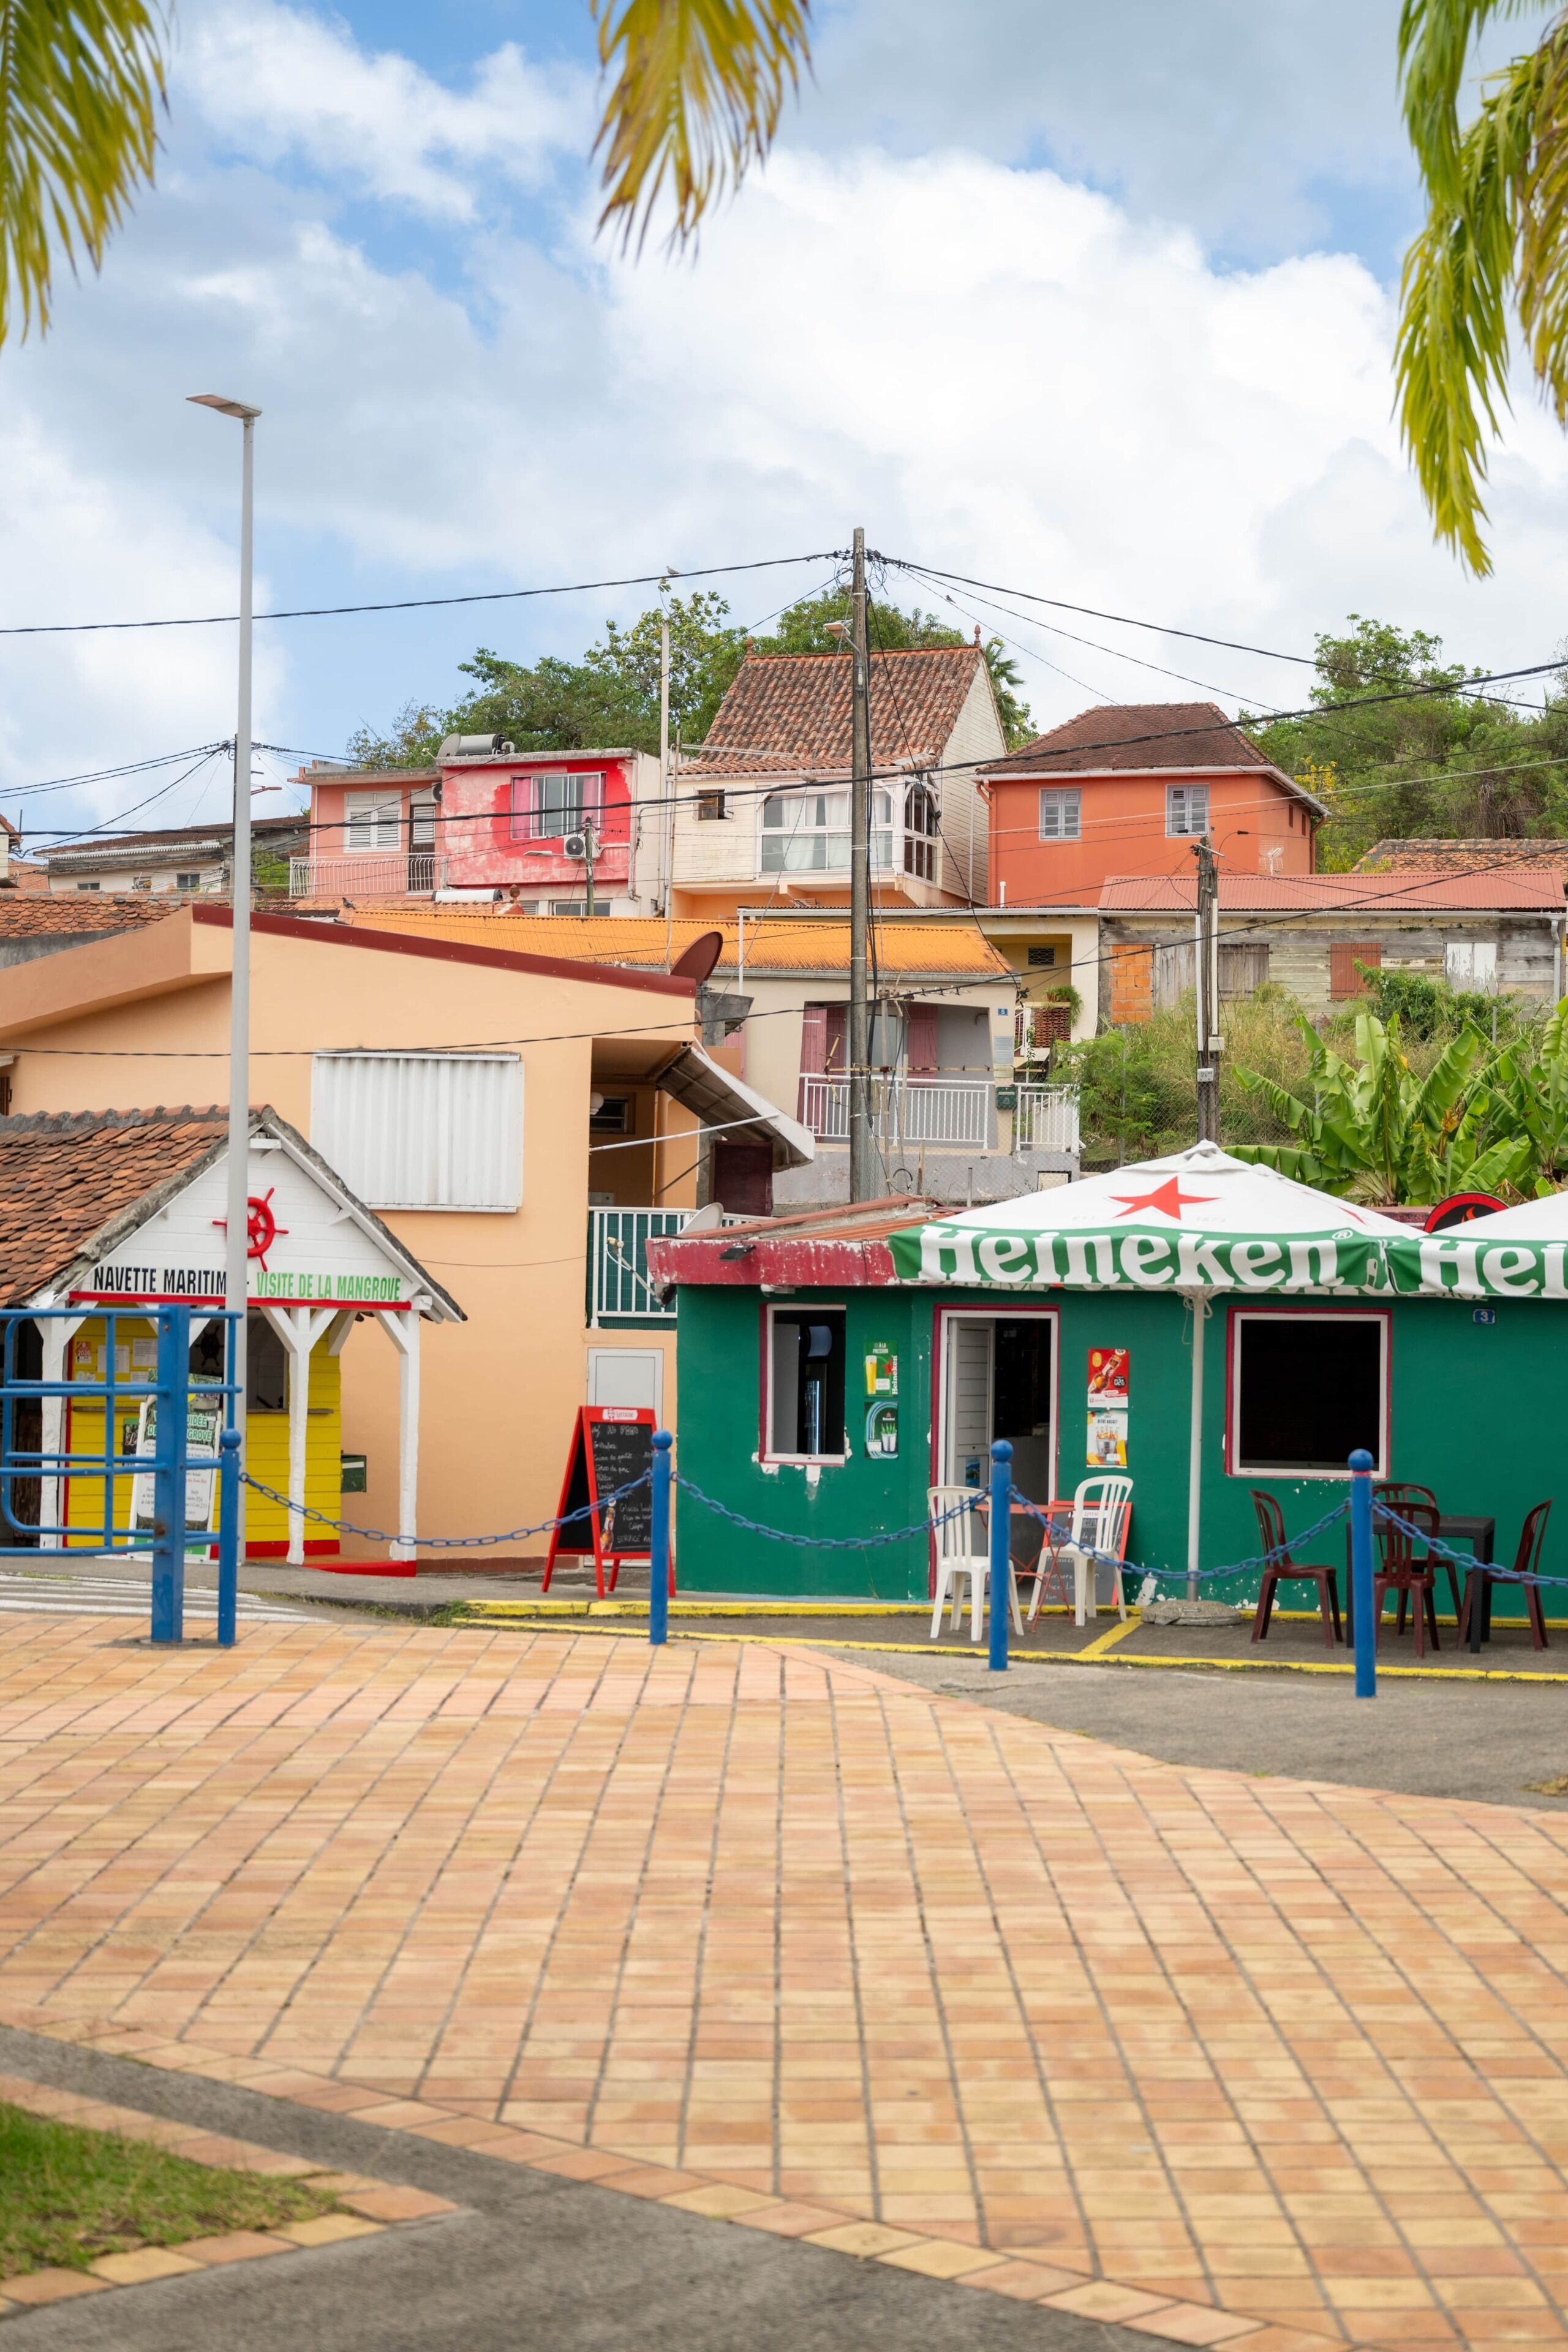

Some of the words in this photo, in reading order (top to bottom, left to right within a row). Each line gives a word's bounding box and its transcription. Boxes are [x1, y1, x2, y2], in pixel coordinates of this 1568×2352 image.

[918, 1225, 1344, 1286] Heineken
[1418, 1238, 1568, 1297] Hei
[94, 1267, 156, 1292] NAVETTE
[164, 1269, 227, 1295] MARITIM
[257, 1272, 294, 1297] VISITE
[299, 1274, 313, 1297] DE
[318, 1274, 331, 1298] LA
[337, 1275, 401, 1300] MANGROVE
[1480, 1311, 1488, 1322] 3
[188, 1430, 211, 1441] GROVE
